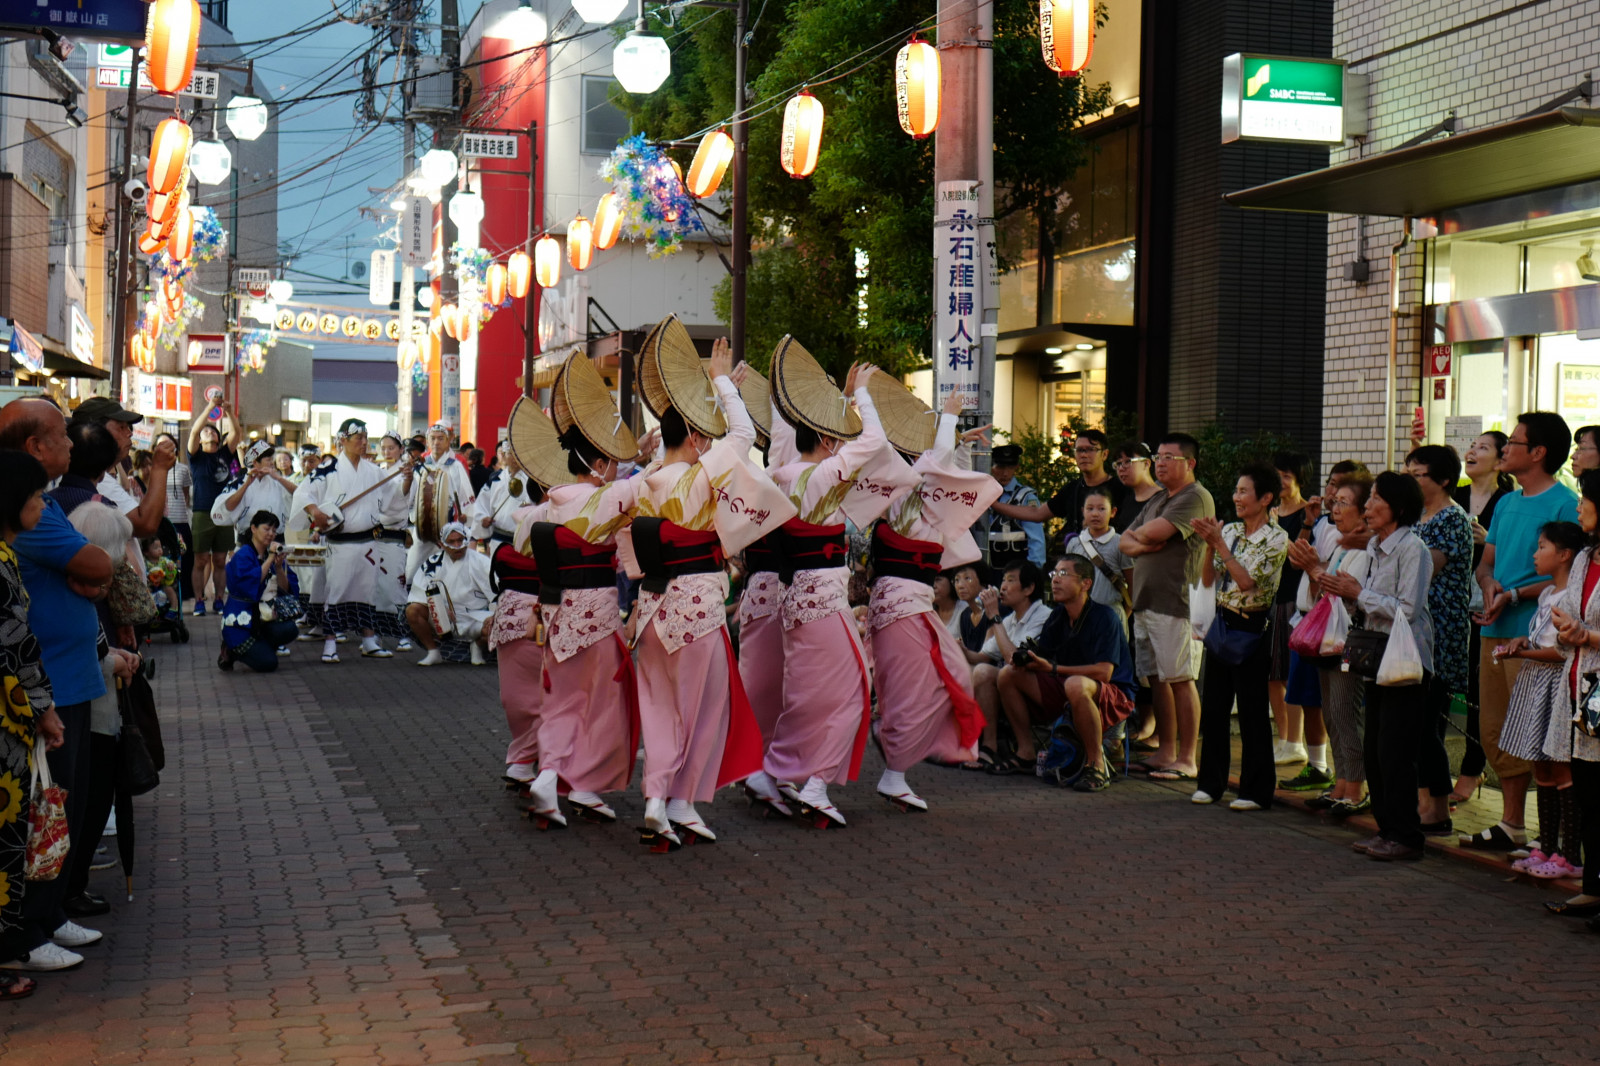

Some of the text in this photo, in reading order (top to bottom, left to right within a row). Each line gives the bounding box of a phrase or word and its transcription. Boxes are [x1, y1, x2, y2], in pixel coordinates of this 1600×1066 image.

[50, 10, 109, 26] 御嶽山店
[1269, 88, 1296, 99] SMBC
[949, 209, 974, 371] 永石産婦人科
[1433, 346, 1450, 355] AED
[711, 486, 770, 526] すのき連
